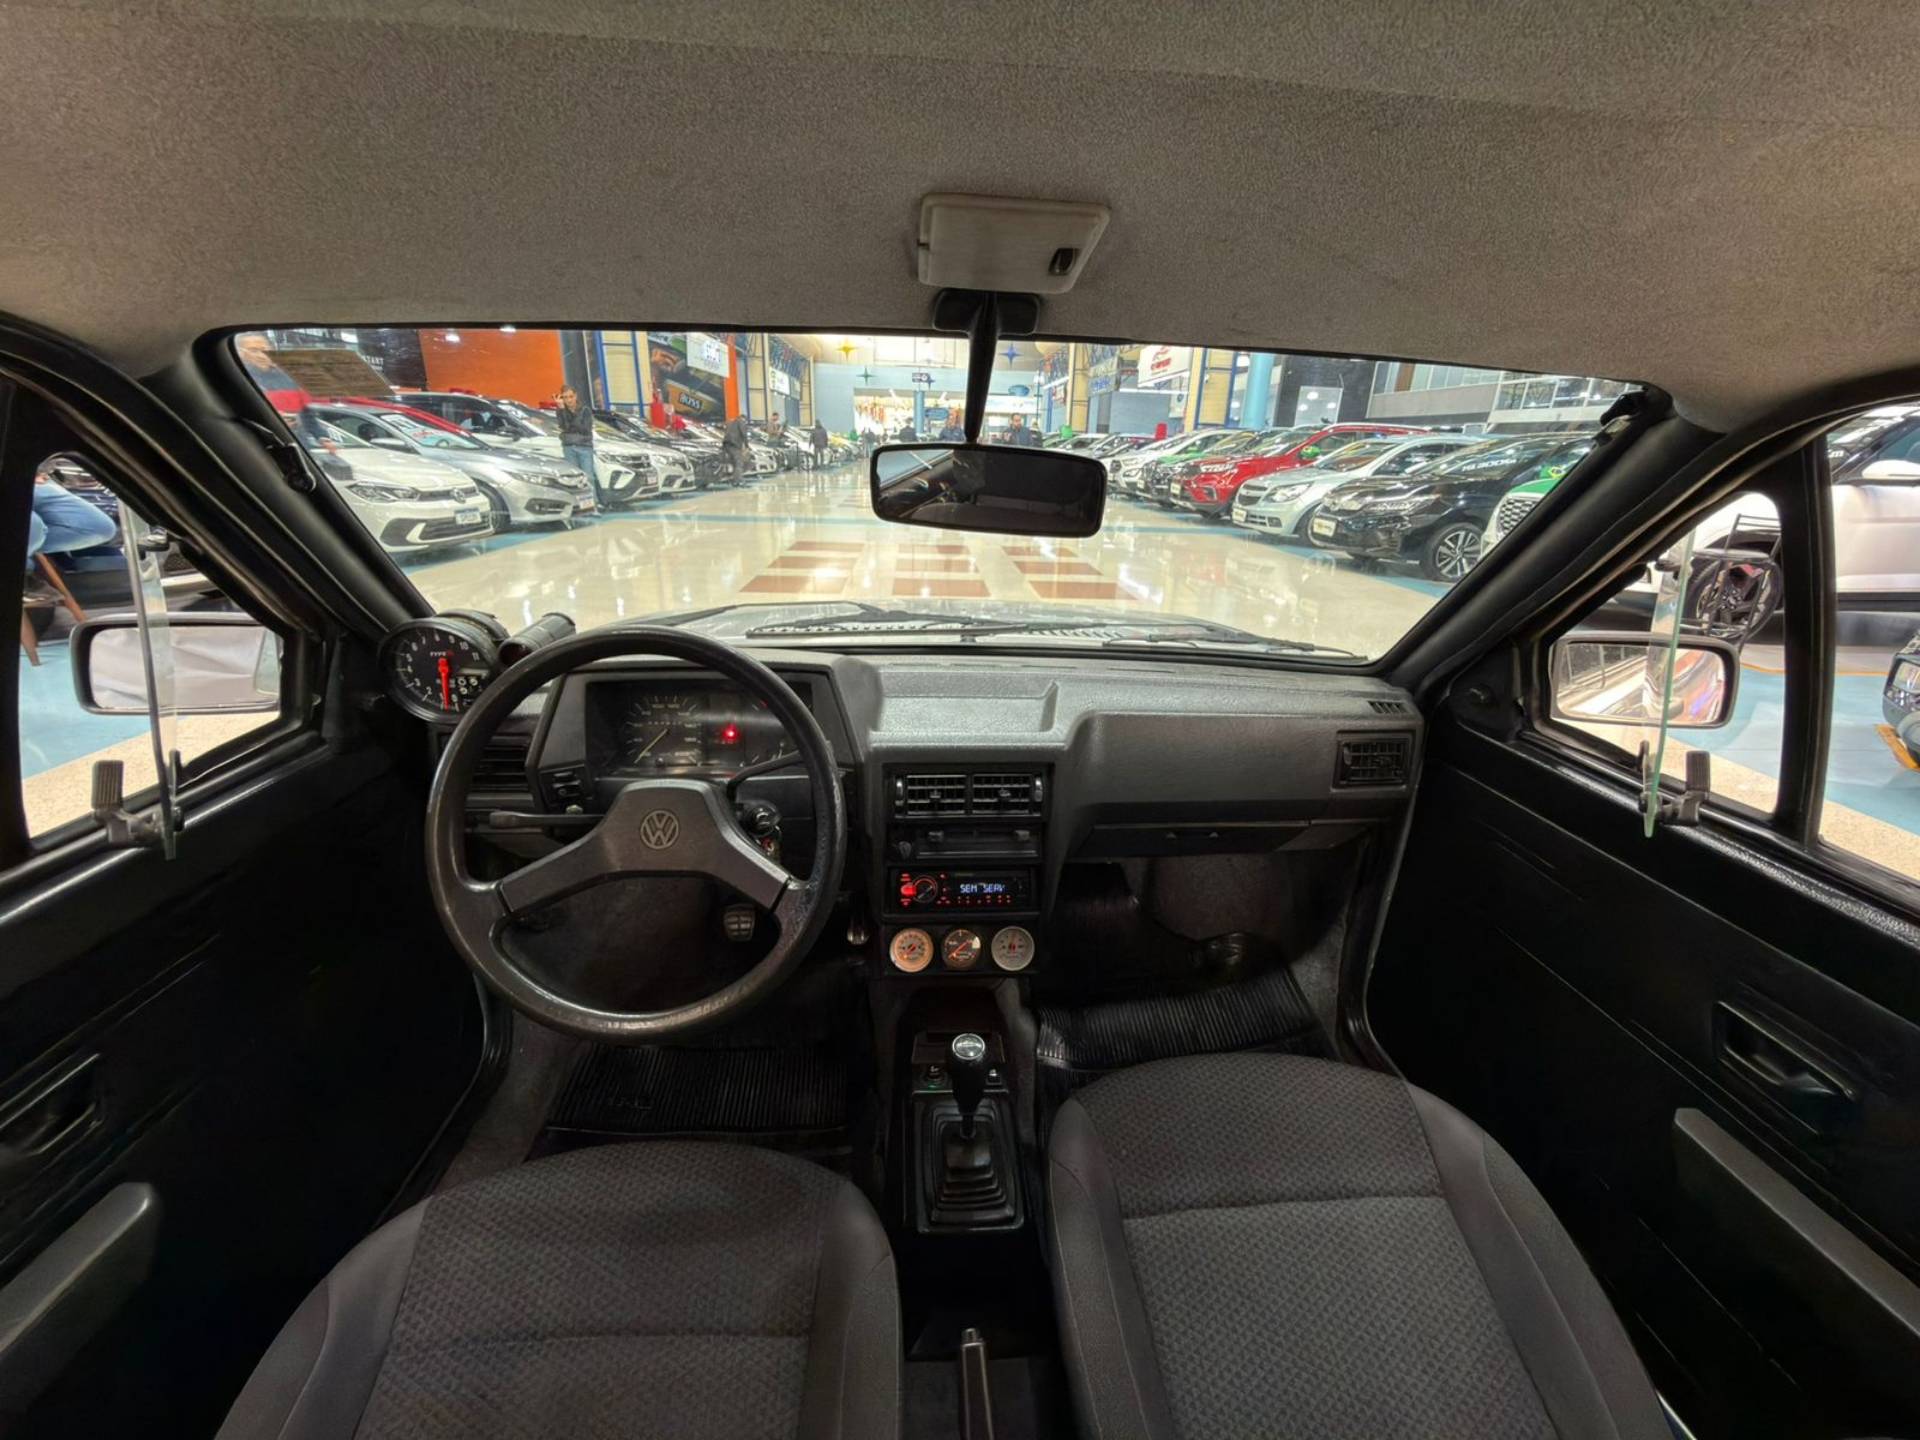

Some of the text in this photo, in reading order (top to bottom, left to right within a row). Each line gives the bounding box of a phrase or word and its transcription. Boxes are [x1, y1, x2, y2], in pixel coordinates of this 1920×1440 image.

[459, 641, 469, 650] 10
[472, 652, 480, 661] 11
[960, 883, 978, 894] SEM
